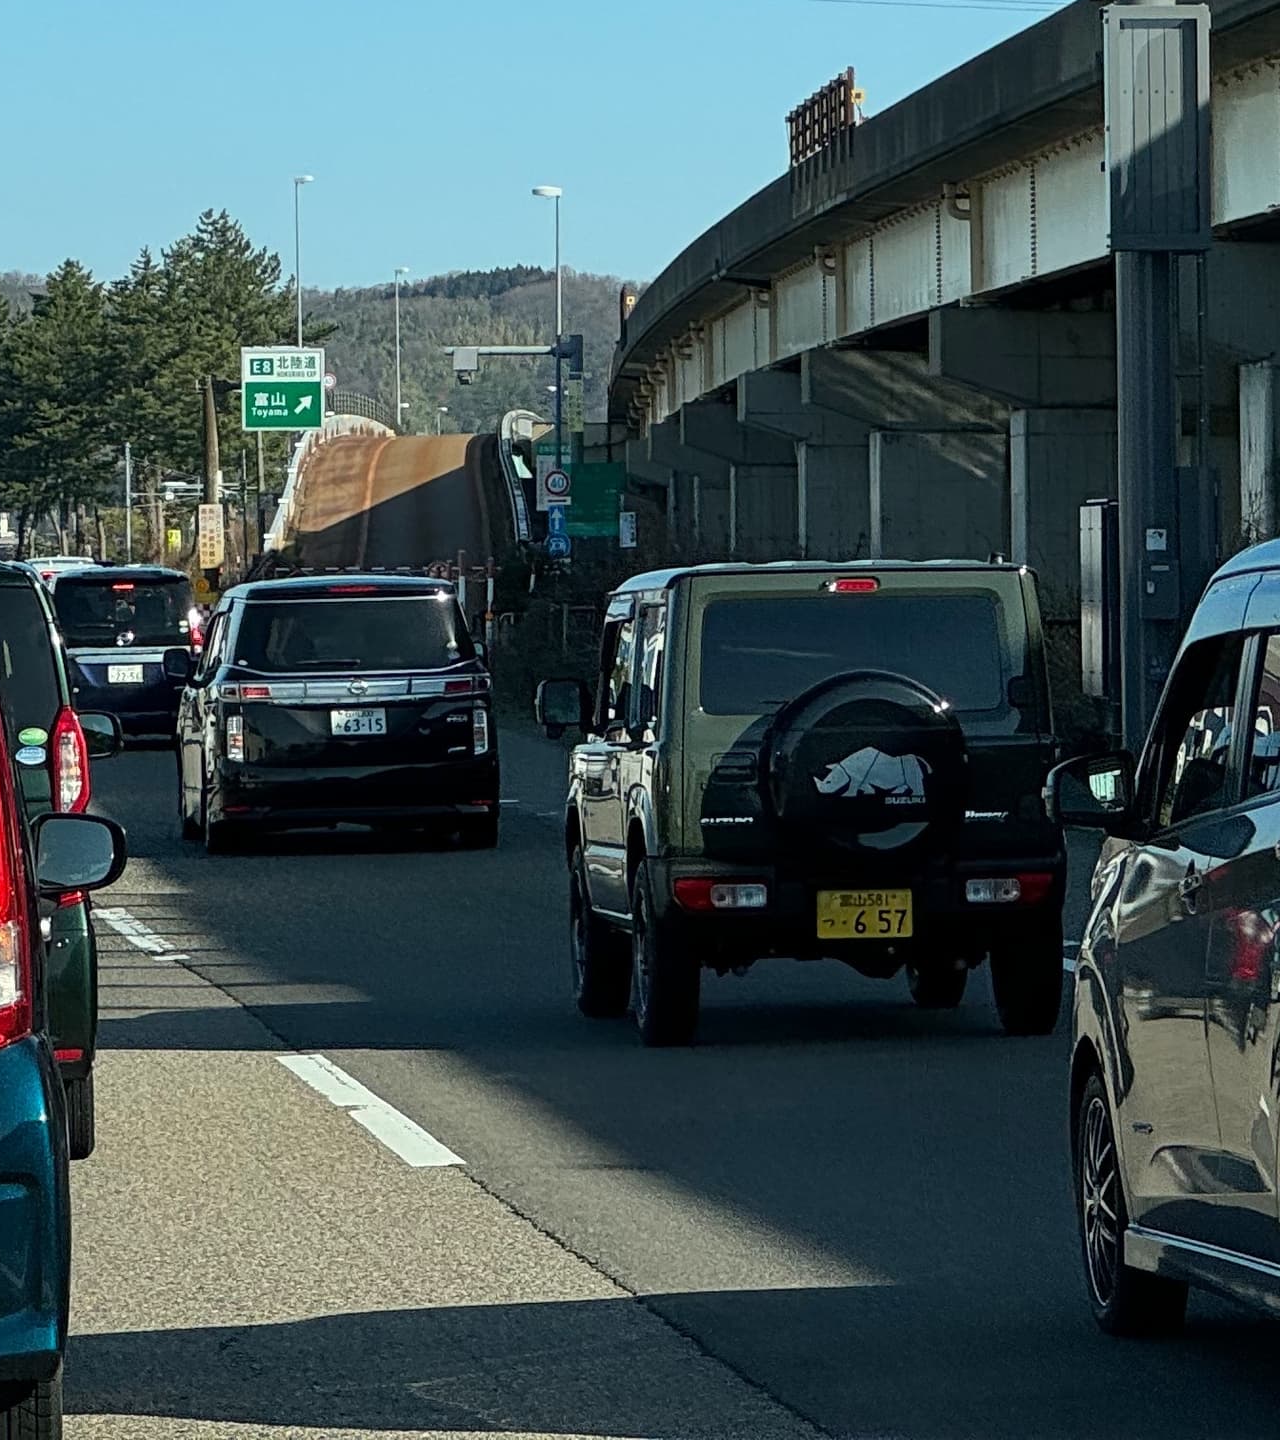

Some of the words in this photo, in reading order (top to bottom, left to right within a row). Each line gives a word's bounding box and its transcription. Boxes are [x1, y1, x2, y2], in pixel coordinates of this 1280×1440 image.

[252, 360, 271, 374] E8
[251, 407, 289, 419] Toyama
[344, 717, 384, 733] 63-15
[884, 795, 926, 805] SUZUKI
